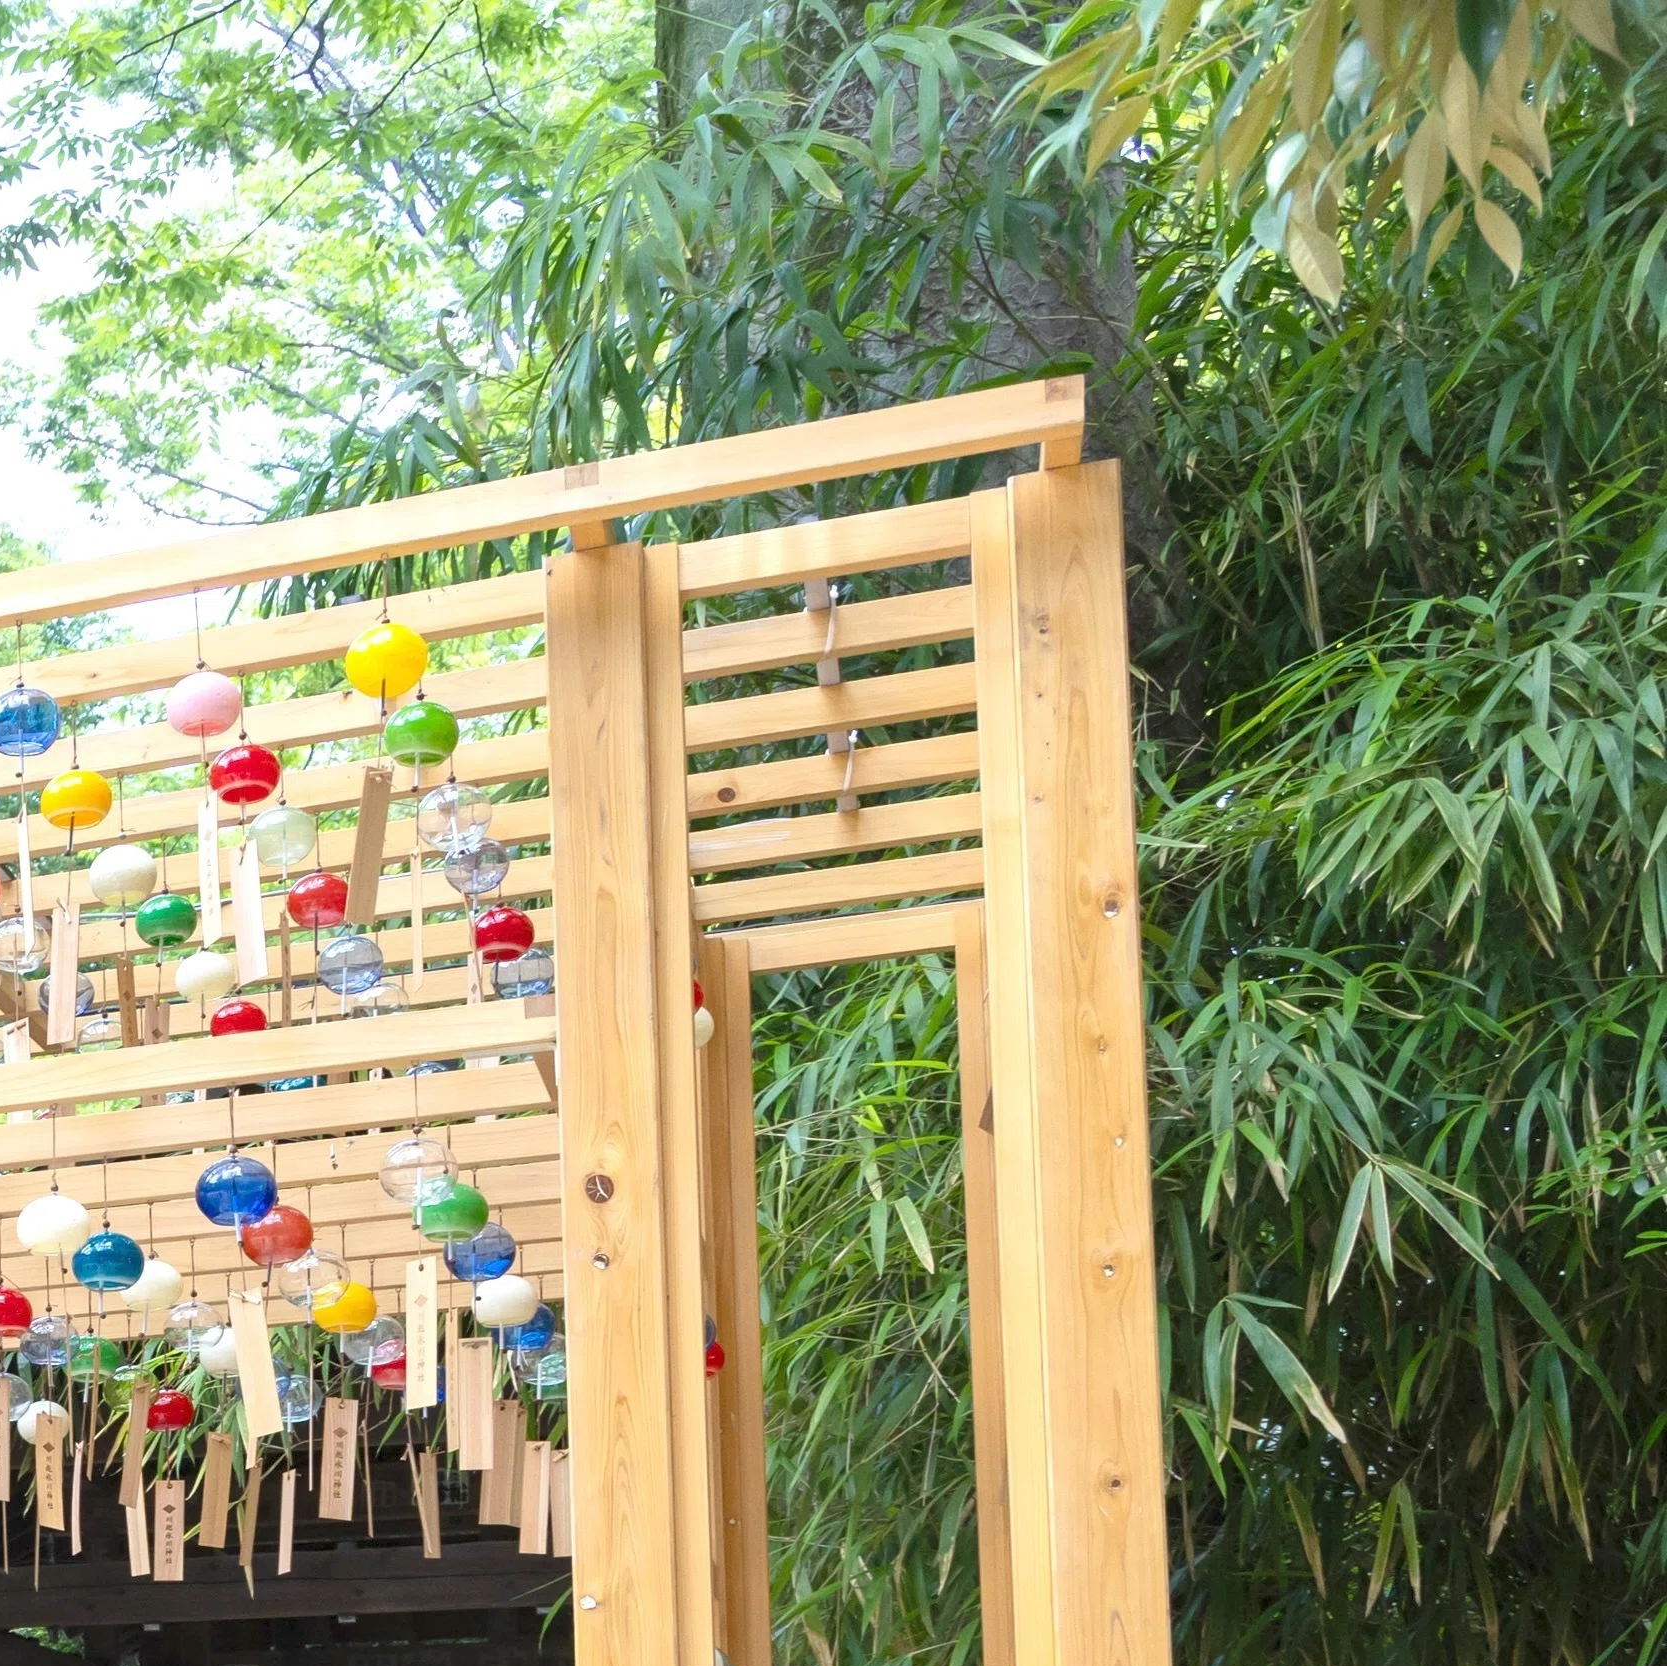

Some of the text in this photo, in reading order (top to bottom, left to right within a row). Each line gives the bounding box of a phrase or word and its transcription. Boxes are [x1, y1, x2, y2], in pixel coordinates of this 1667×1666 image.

[45, 1455, 54, 1511] 川越氷川神社
[334, 1440, 345, 1500] 川越氷川神社
[165, 1515, 174, 1565] 川越氷川神社
